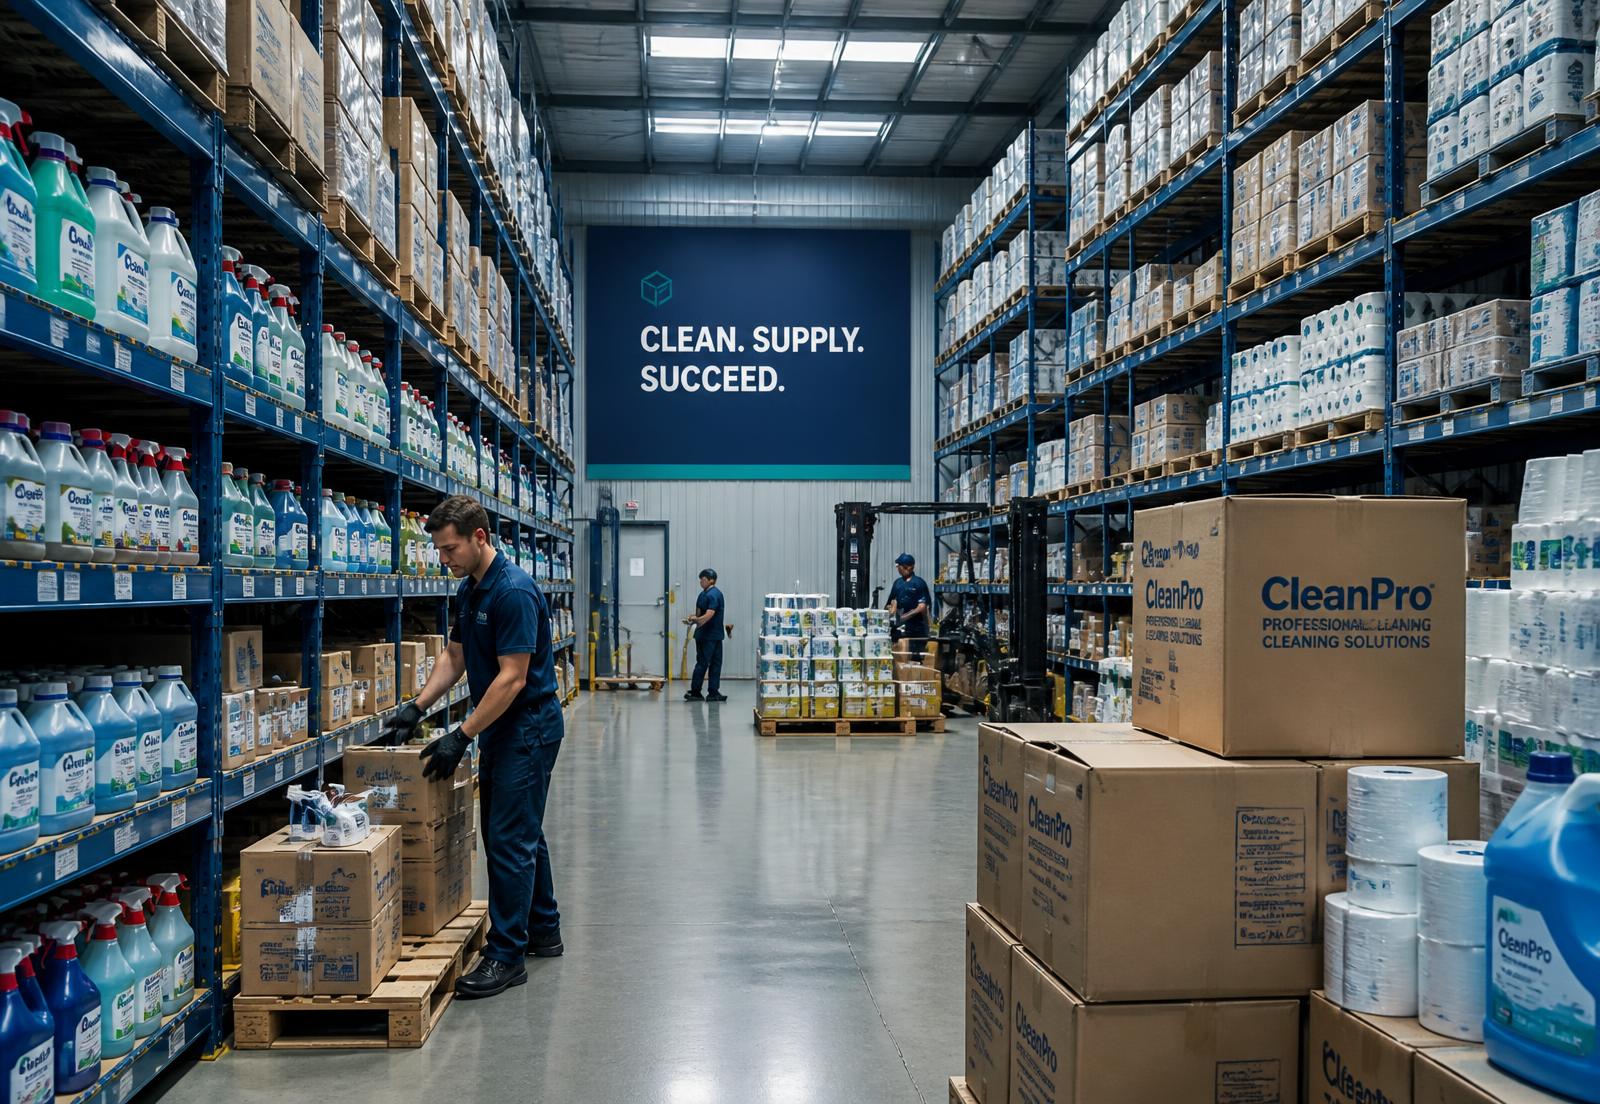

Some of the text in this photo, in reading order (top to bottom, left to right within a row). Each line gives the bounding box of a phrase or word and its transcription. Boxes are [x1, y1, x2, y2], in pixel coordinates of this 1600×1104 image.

[640, 325, 865, 353] CLEAN. SUPPLY.
[640, 364, 786, 392] SUCCEED.
[1145, 579, 1204, 611] CleanPro
[1262, 635, 1430, 649] CLEANING SOLUTIONS
